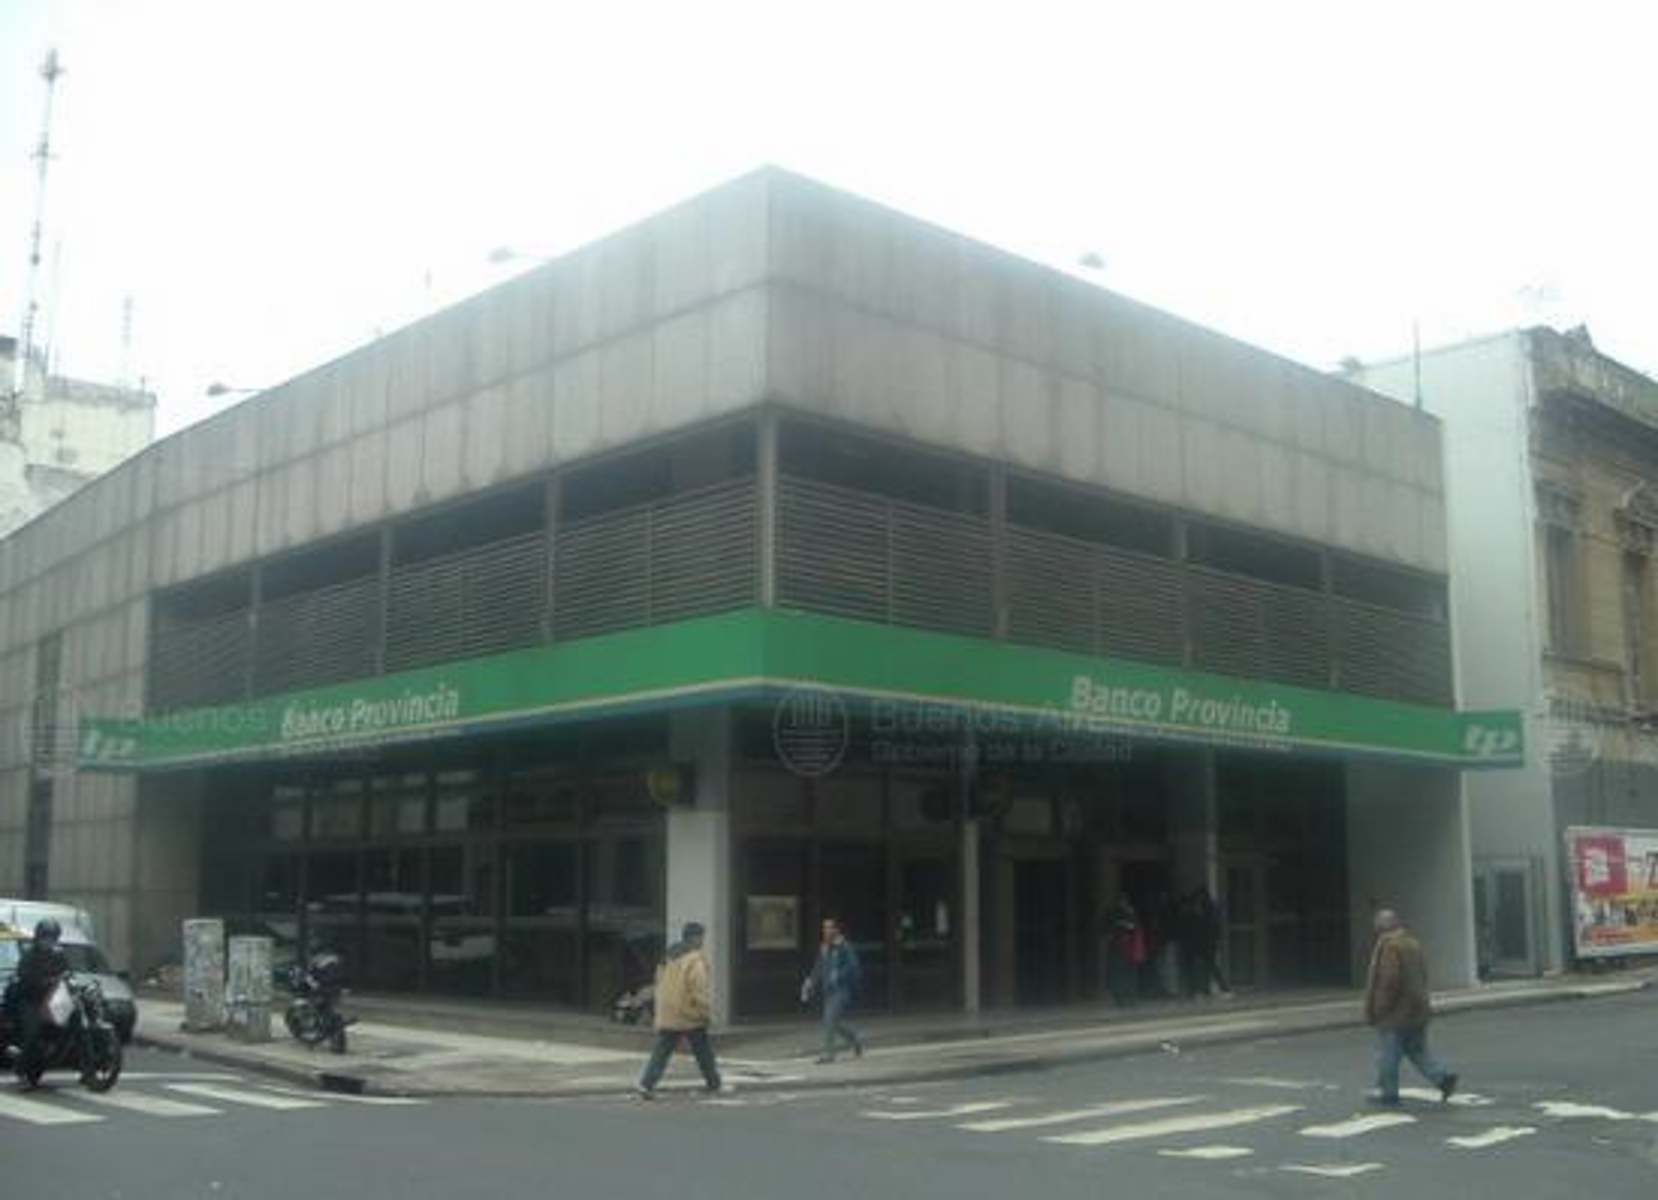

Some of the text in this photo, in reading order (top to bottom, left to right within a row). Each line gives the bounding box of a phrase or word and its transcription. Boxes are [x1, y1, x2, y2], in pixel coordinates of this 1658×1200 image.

[352, 683, 459, 730] Provincia
[1072, 676, 1291, 733] Banco Provincia
